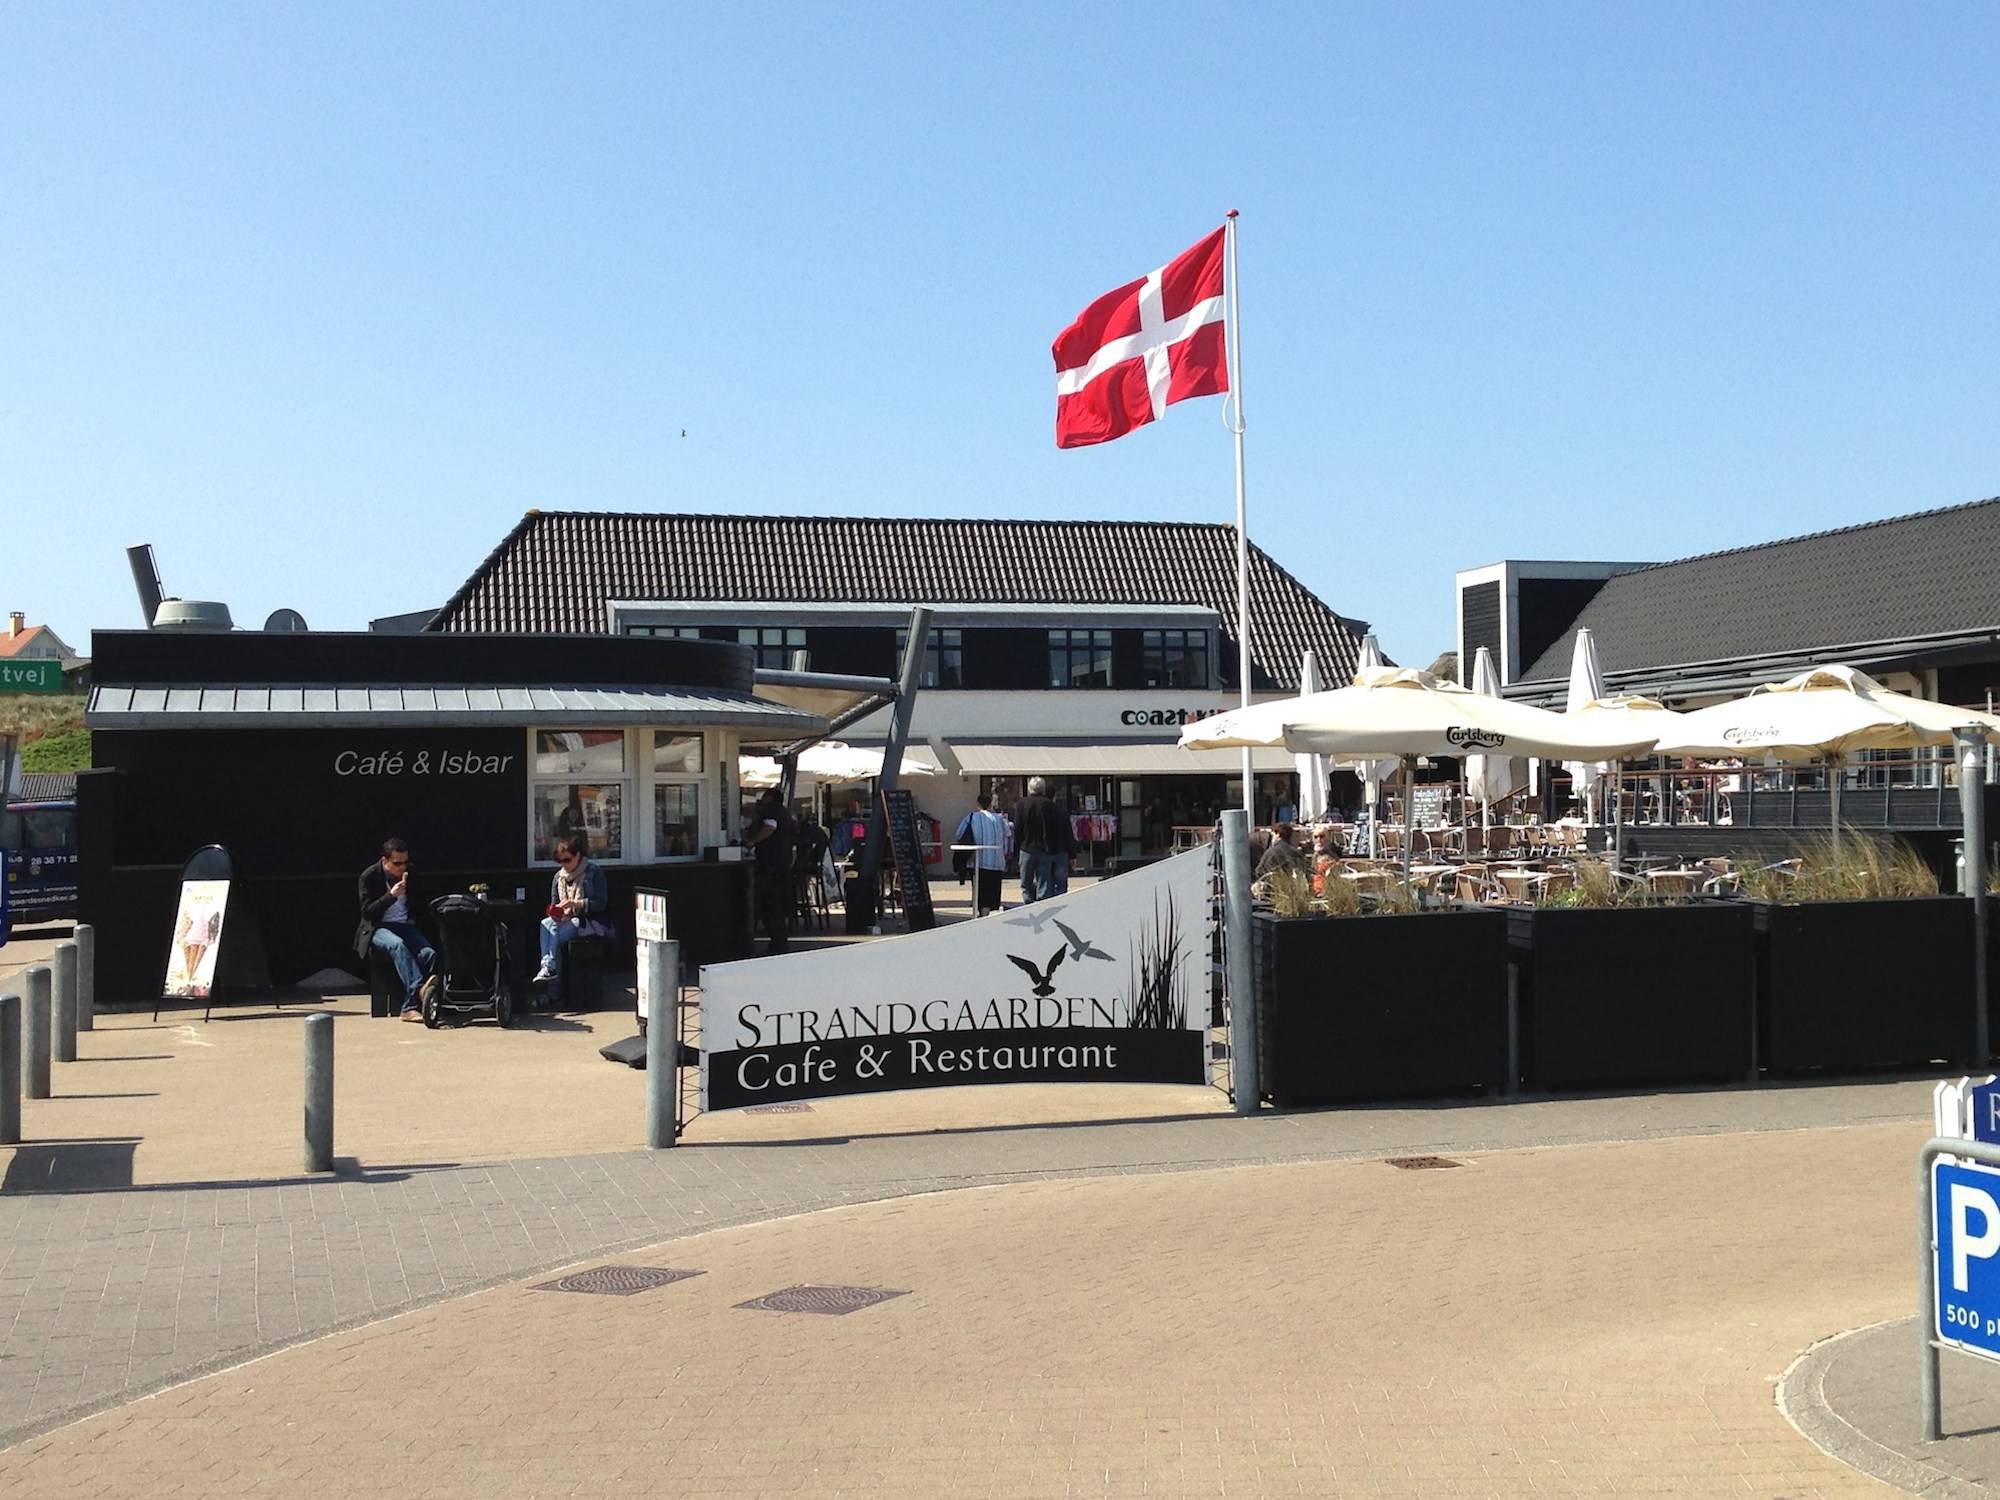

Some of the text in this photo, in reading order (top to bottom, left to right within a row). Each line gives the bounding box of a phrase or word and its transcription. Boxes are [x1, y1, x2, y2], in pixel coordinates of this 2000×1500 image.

[3, 665, 46, 686] tvej
[1446, 726, 1506, 748] Carlsberg
[334, 750, 514, 776] Café & Isbar
[737, 1038, 1118, 1091] Cafe & Restaurant
[1951, 1183, 2000, 1293] P
[1947, 1304, 1980, 1330] 500
